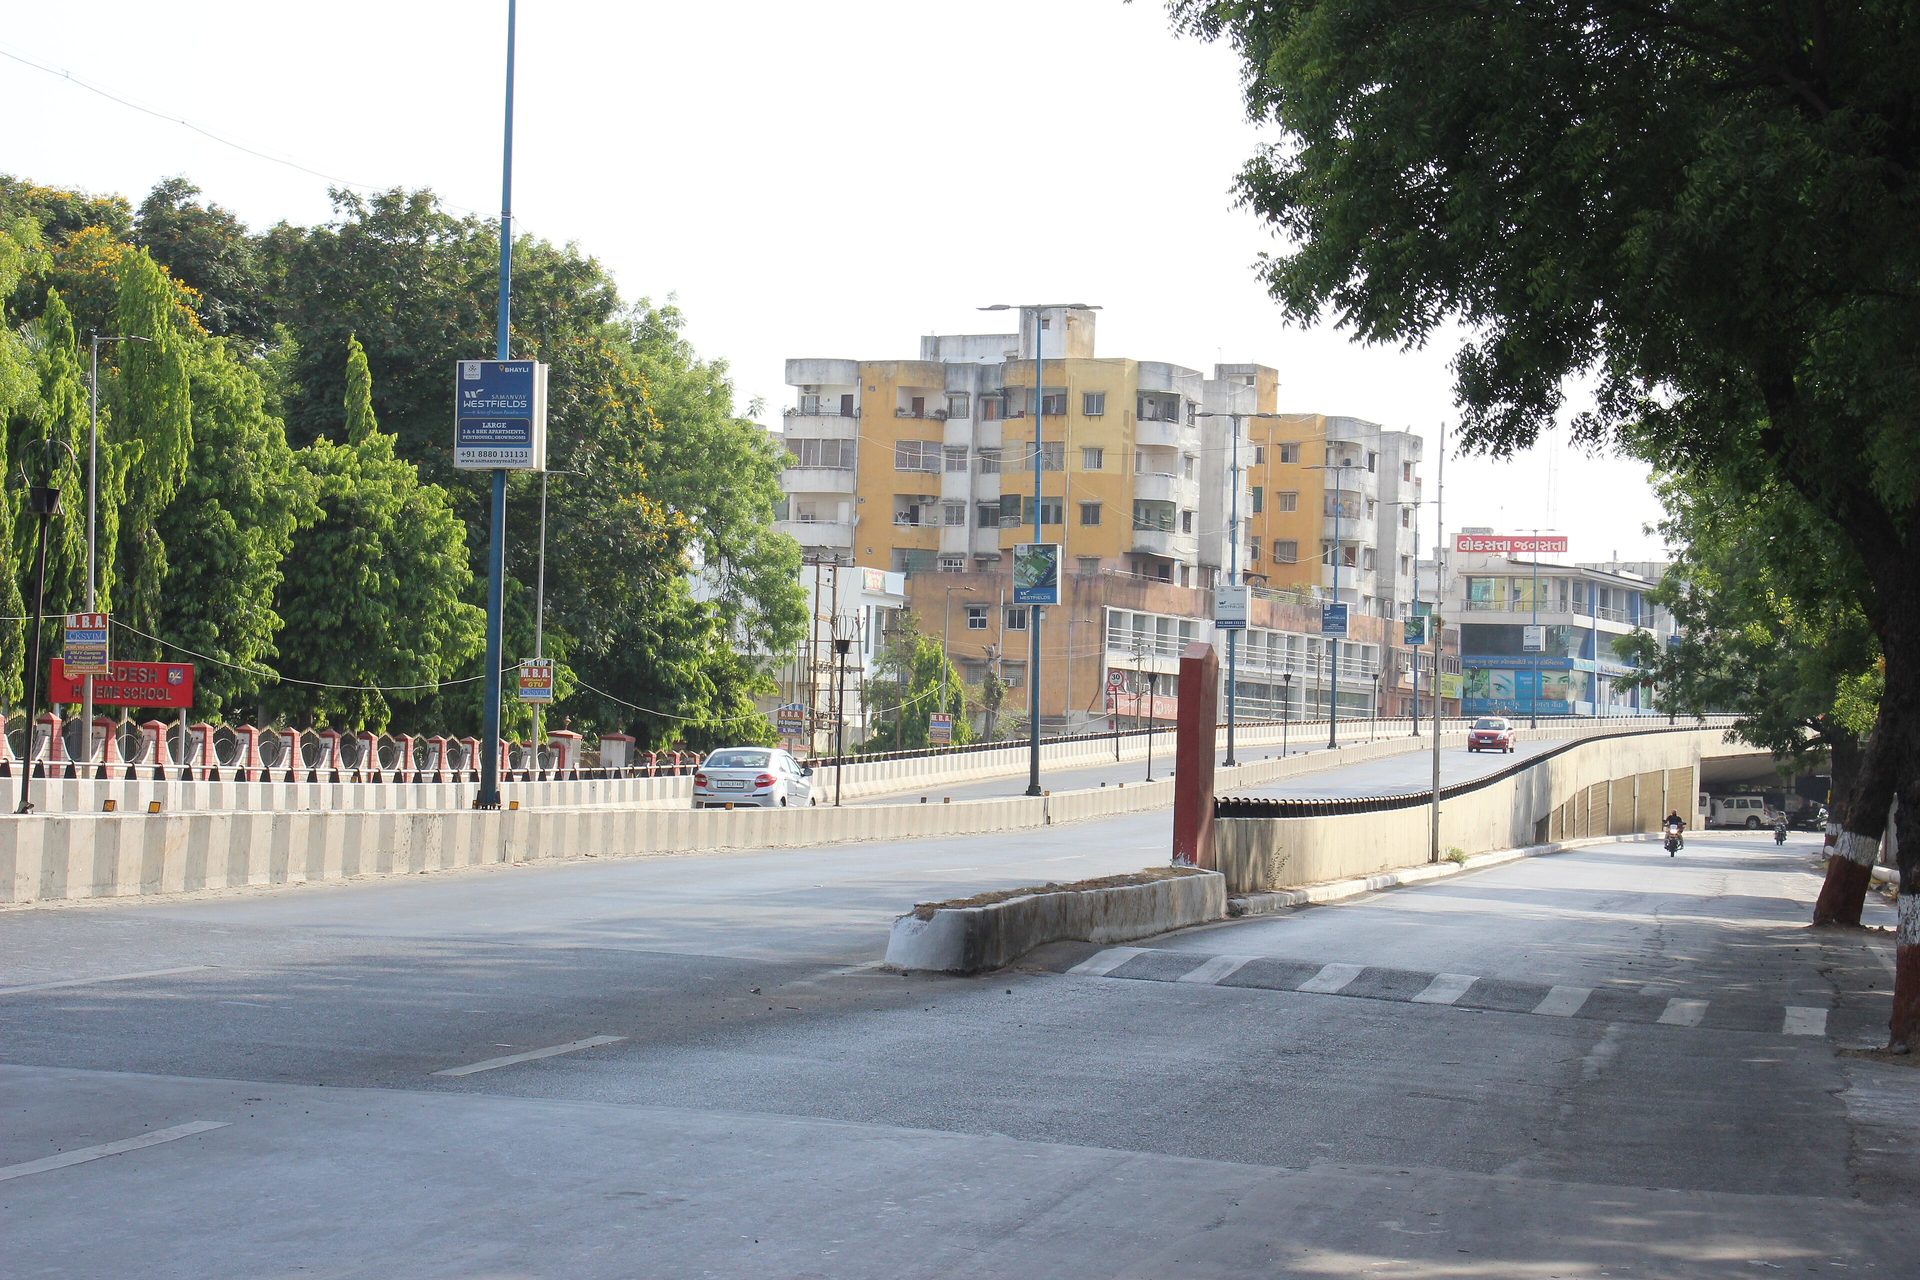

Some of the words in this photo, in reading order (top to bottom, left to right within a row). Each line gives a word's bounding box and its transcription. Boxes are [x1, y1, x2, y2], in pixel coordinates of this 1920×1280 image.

[464, 400, 527, 408] WESTFIELDS
[1459, 537, 1510, 551] લોકસત્તા
[1514, 540, 1566, 551] જનસત્તા
[96, 686, 120, 699] EME
[123, 687, 172, 700] SCHOOL
